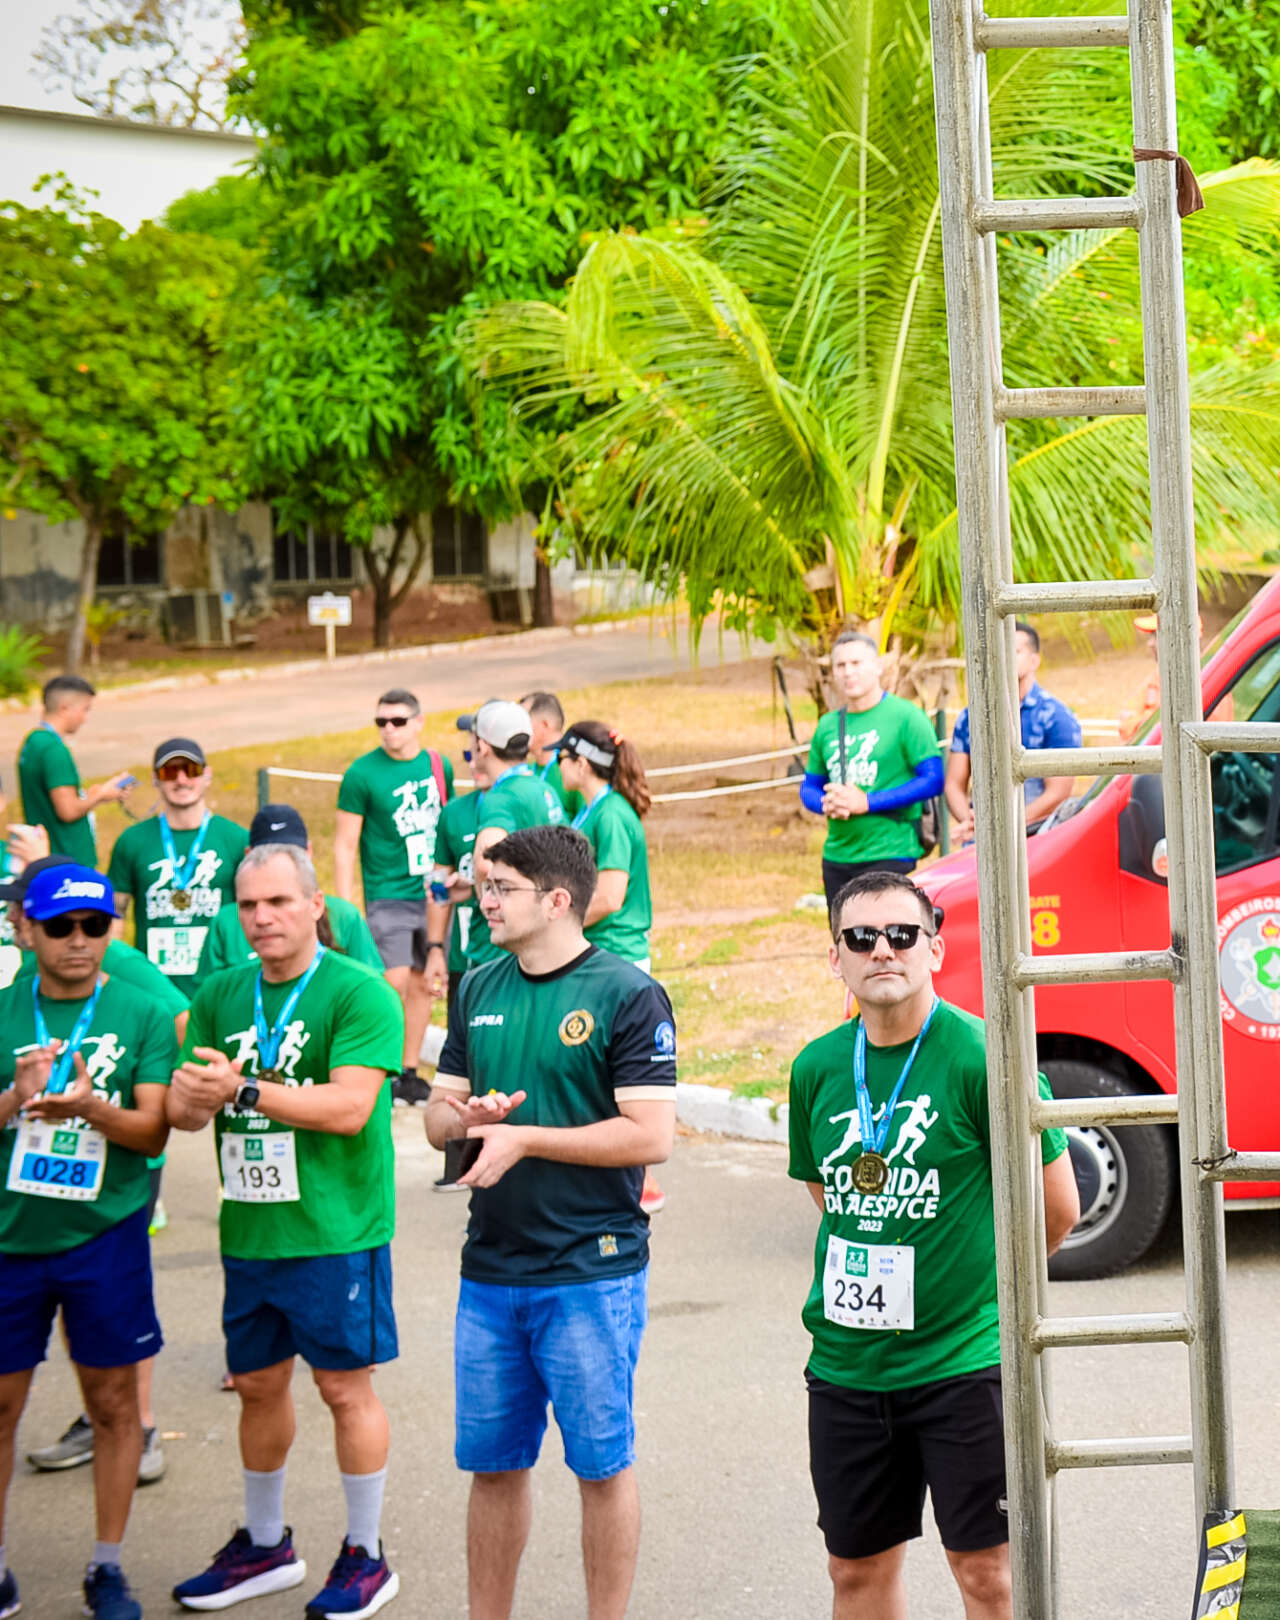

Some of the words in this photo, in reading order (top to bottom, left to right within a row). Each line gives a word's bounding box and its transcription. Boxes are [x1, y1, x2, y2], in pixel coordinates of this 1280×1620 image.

[1029, 895, 1061, 908] GATE
[32, 1157, 87, 1186] 028
[238, 1165, 281, 1189] 193
[821, 1164, 941, 1196] COIDA
[845, 1193, 940, 1220] AESP/CE
[857, 1218, 883, 1233] 2023
[834, 1278, 887, 1313] 234
